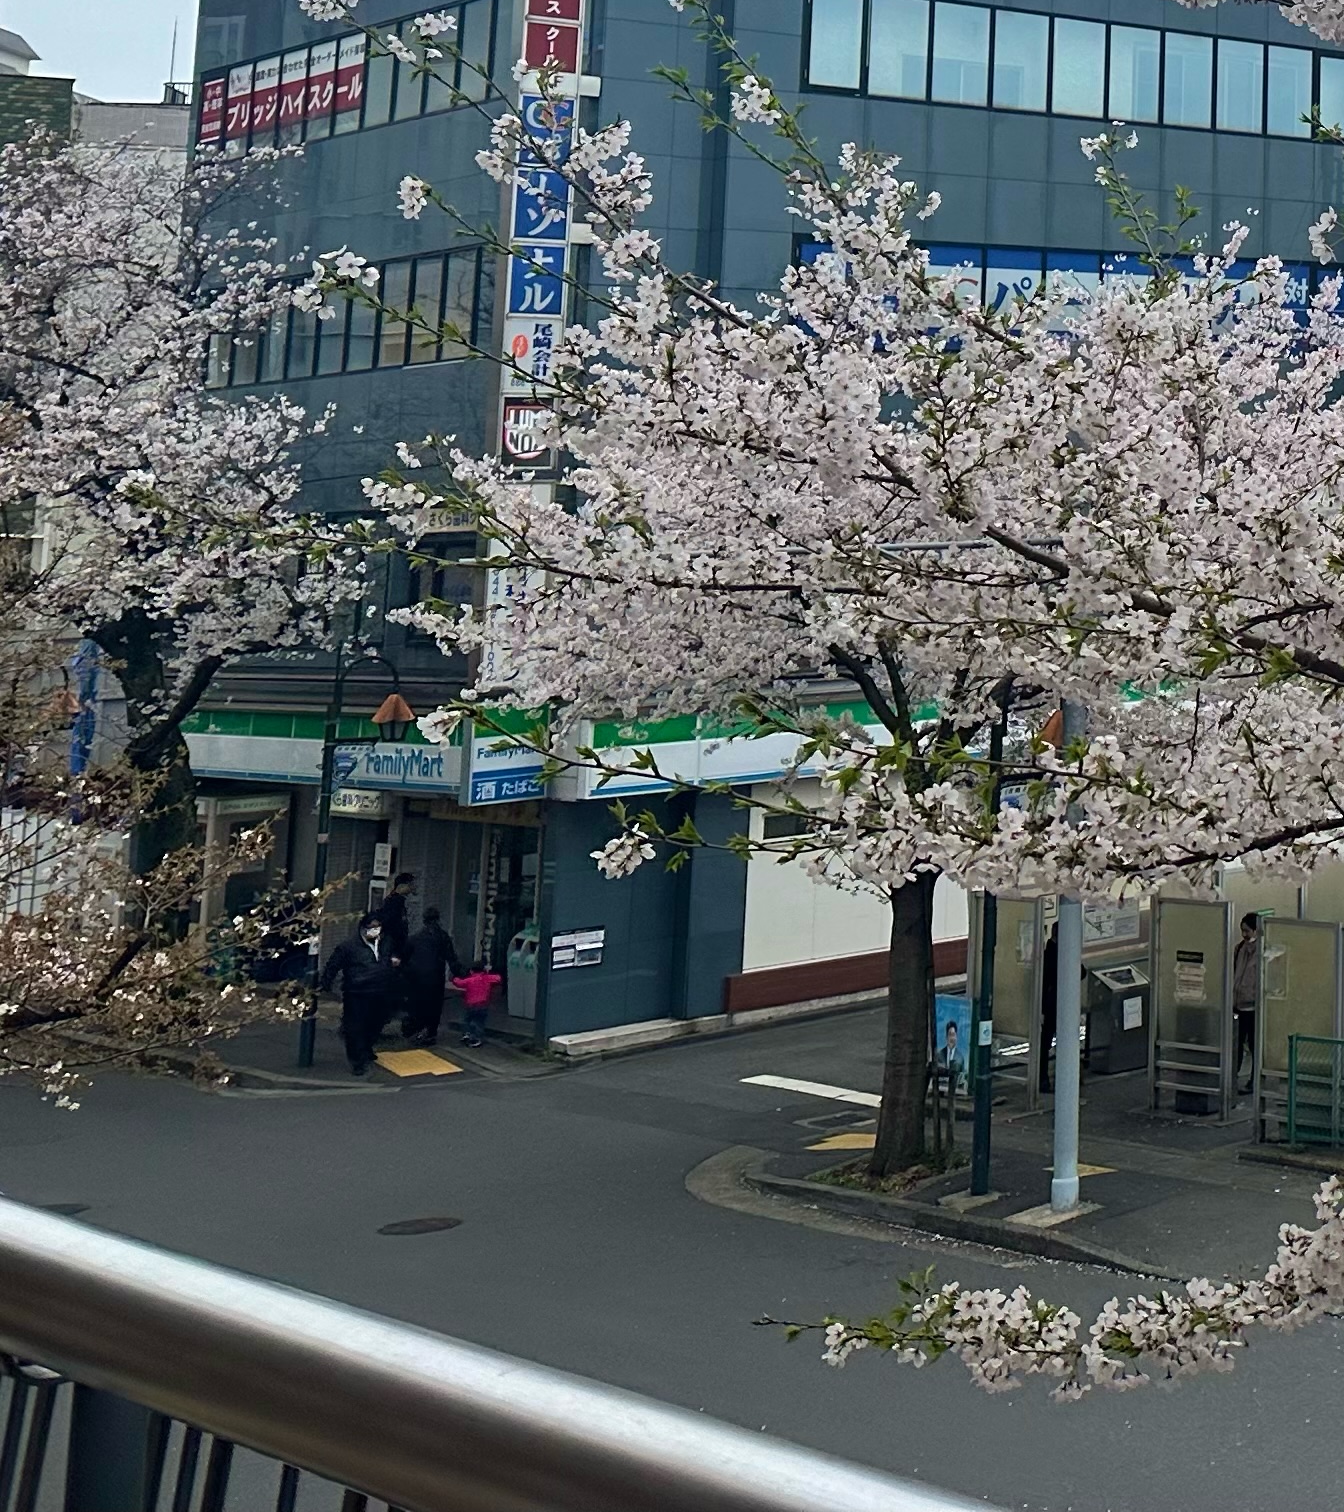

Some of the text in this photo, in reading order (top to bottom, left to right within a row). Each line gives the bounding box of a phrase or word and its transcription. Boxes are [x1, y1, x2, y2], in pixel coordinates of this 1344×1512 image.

[226, 72, 364, 133] ブリッジハイスクール
[366, 747, 445, 784] FamilyMart
[476, 781, 497, 800] 酒
